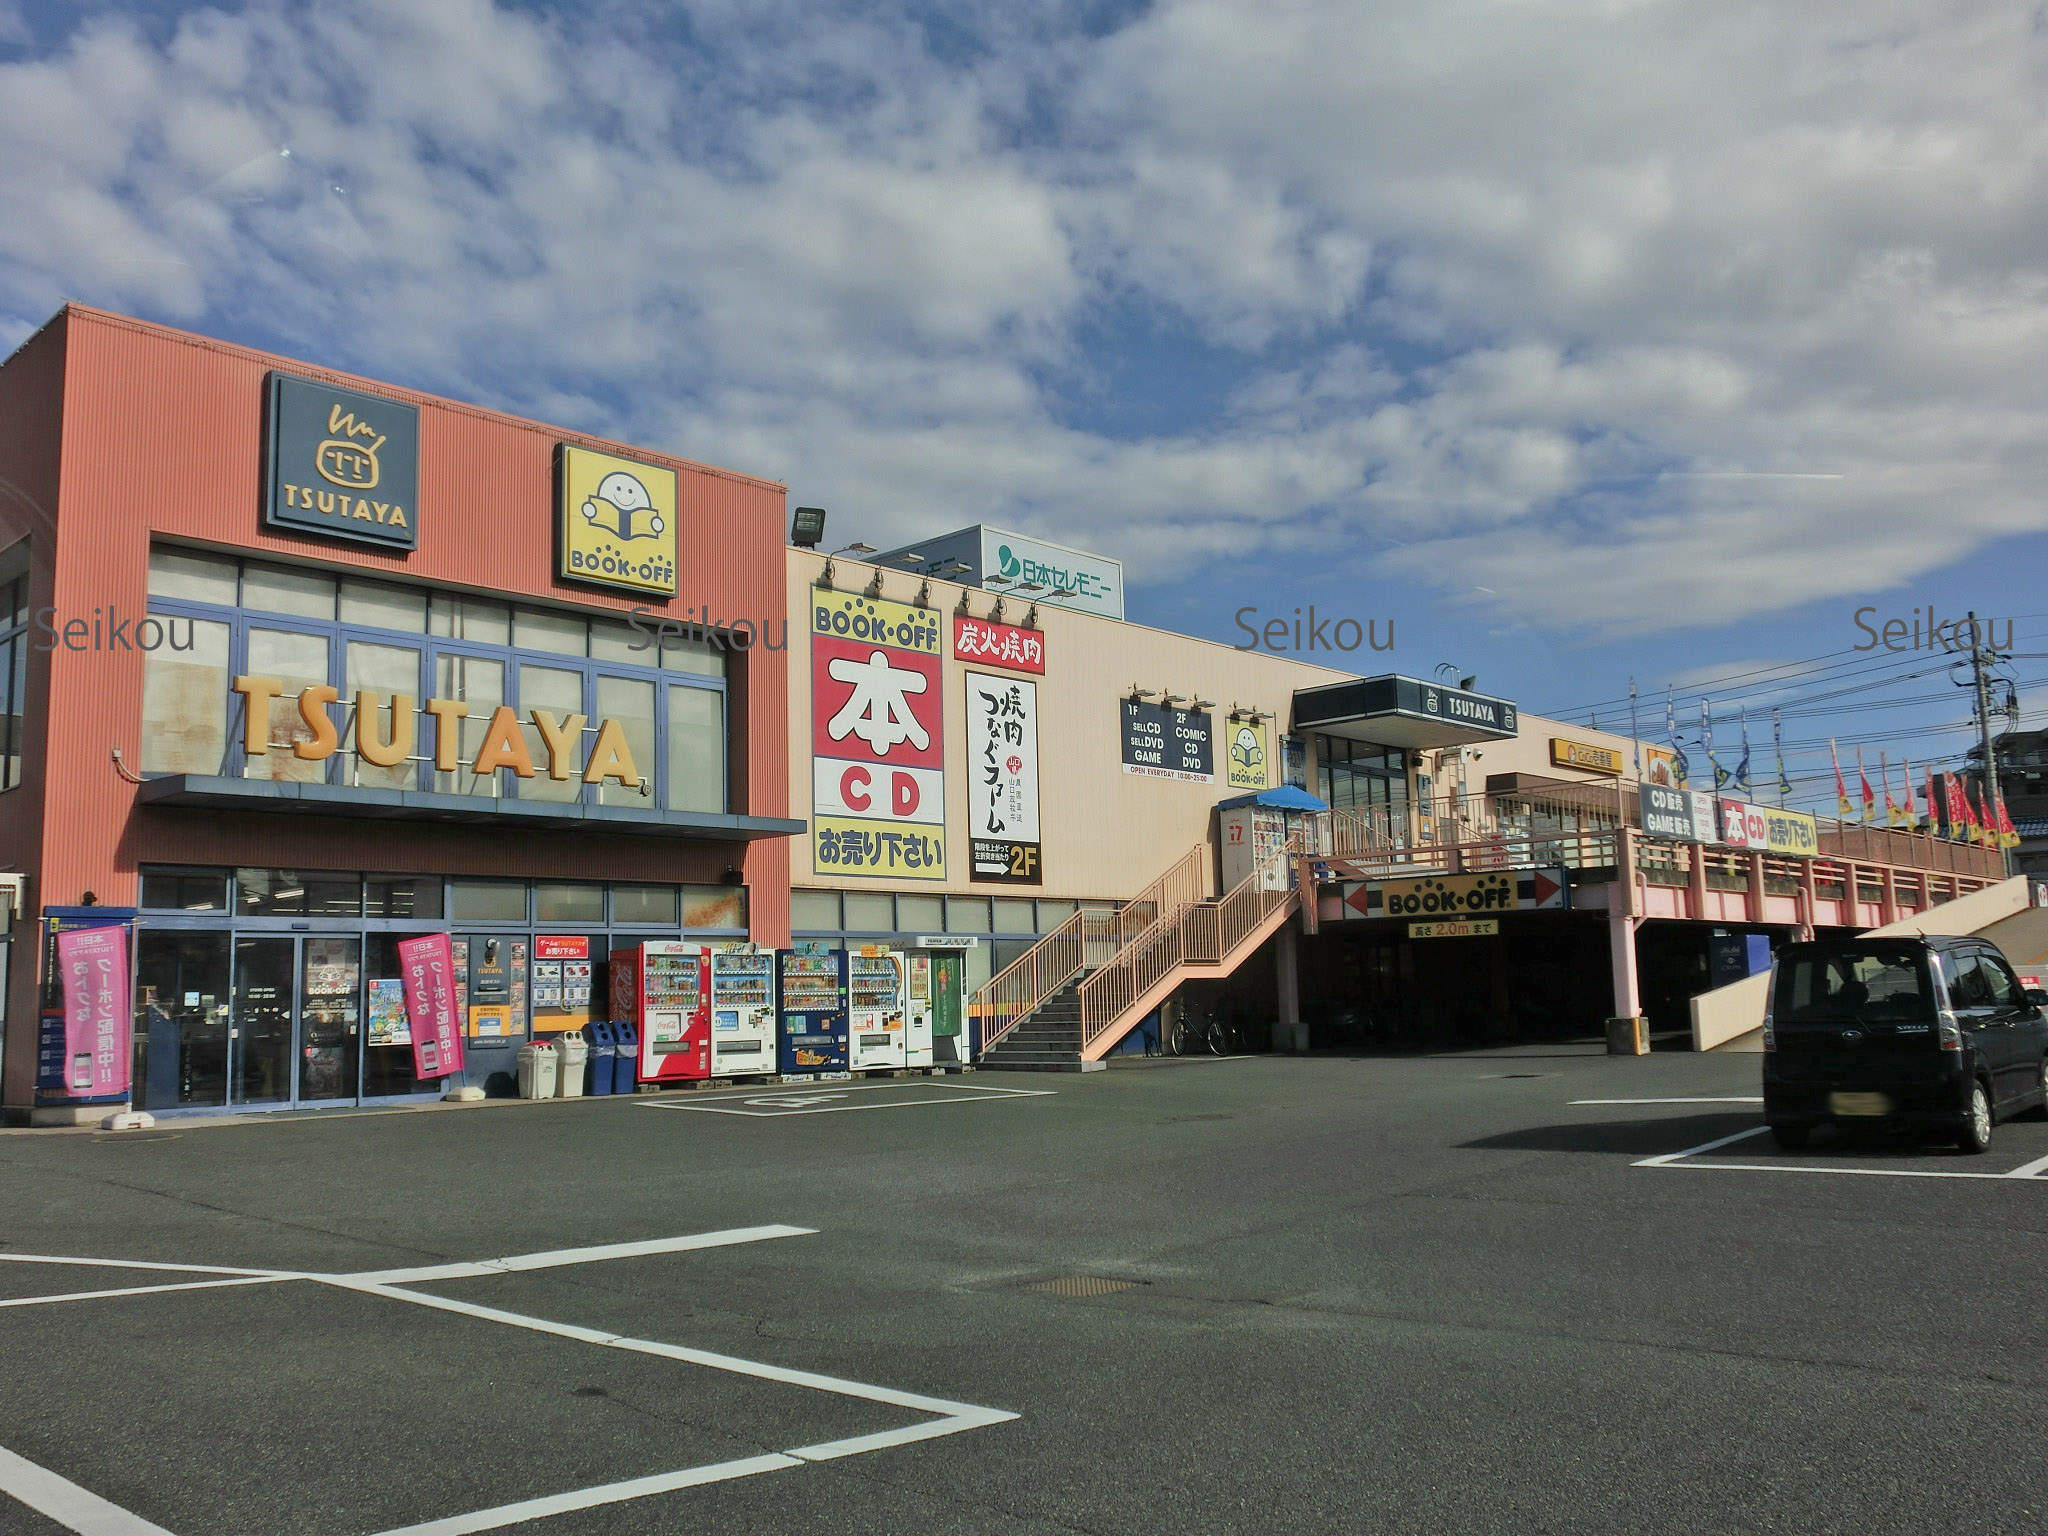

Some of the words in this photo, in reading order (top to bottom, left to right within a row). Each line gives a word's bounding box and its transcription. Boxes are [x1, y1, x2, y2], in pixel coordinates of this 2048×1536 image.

[284, 482, 408, 529] TSUTAYA
[1022, 558, 1112, 599] 日本セレモニー
[826, 649, 931, 756] 本
[1127, 703, 1139, 716] 1F
[1449, 697, 1496, 723] TSUTAYA
[1001, 685, 1026, 747] 焼肉
[1176, 712, 1187, 724] 2F
[233, 675, 641, 787] TSUTAYA
[1175, 726, 1207, 742] COMIC
[978, 689, 1006, 834] つなぐファーム
[1134, 749, 1162, 764] GAME
[1184, 742, 1198, 755] CD
[1130, 766, 1146, 775] OPEN
[1147, 768, 1175, 778] EVERYDAY
[1182, 756, 1201, 769] DVD
[1725, 805, 1746, 842] 本
[1747, 814, 1765, 840] CD
[1767, 816, 1816, 848] お売り下さい
[817, 828, 942, 870] お売り下さい
[974, 842, 1009, 853] 階段を上がって
[974, 852, 1009, 862] 左折突き当たり
[1010, 845, 1037, 876] 2F
[1415, 926, 1432, 937] 高さ
[1436, 923, 1469, 936] 2.0m
[1473, 923, 1491, 934] まで
[545, 947, 580, 955] お売り下さい
